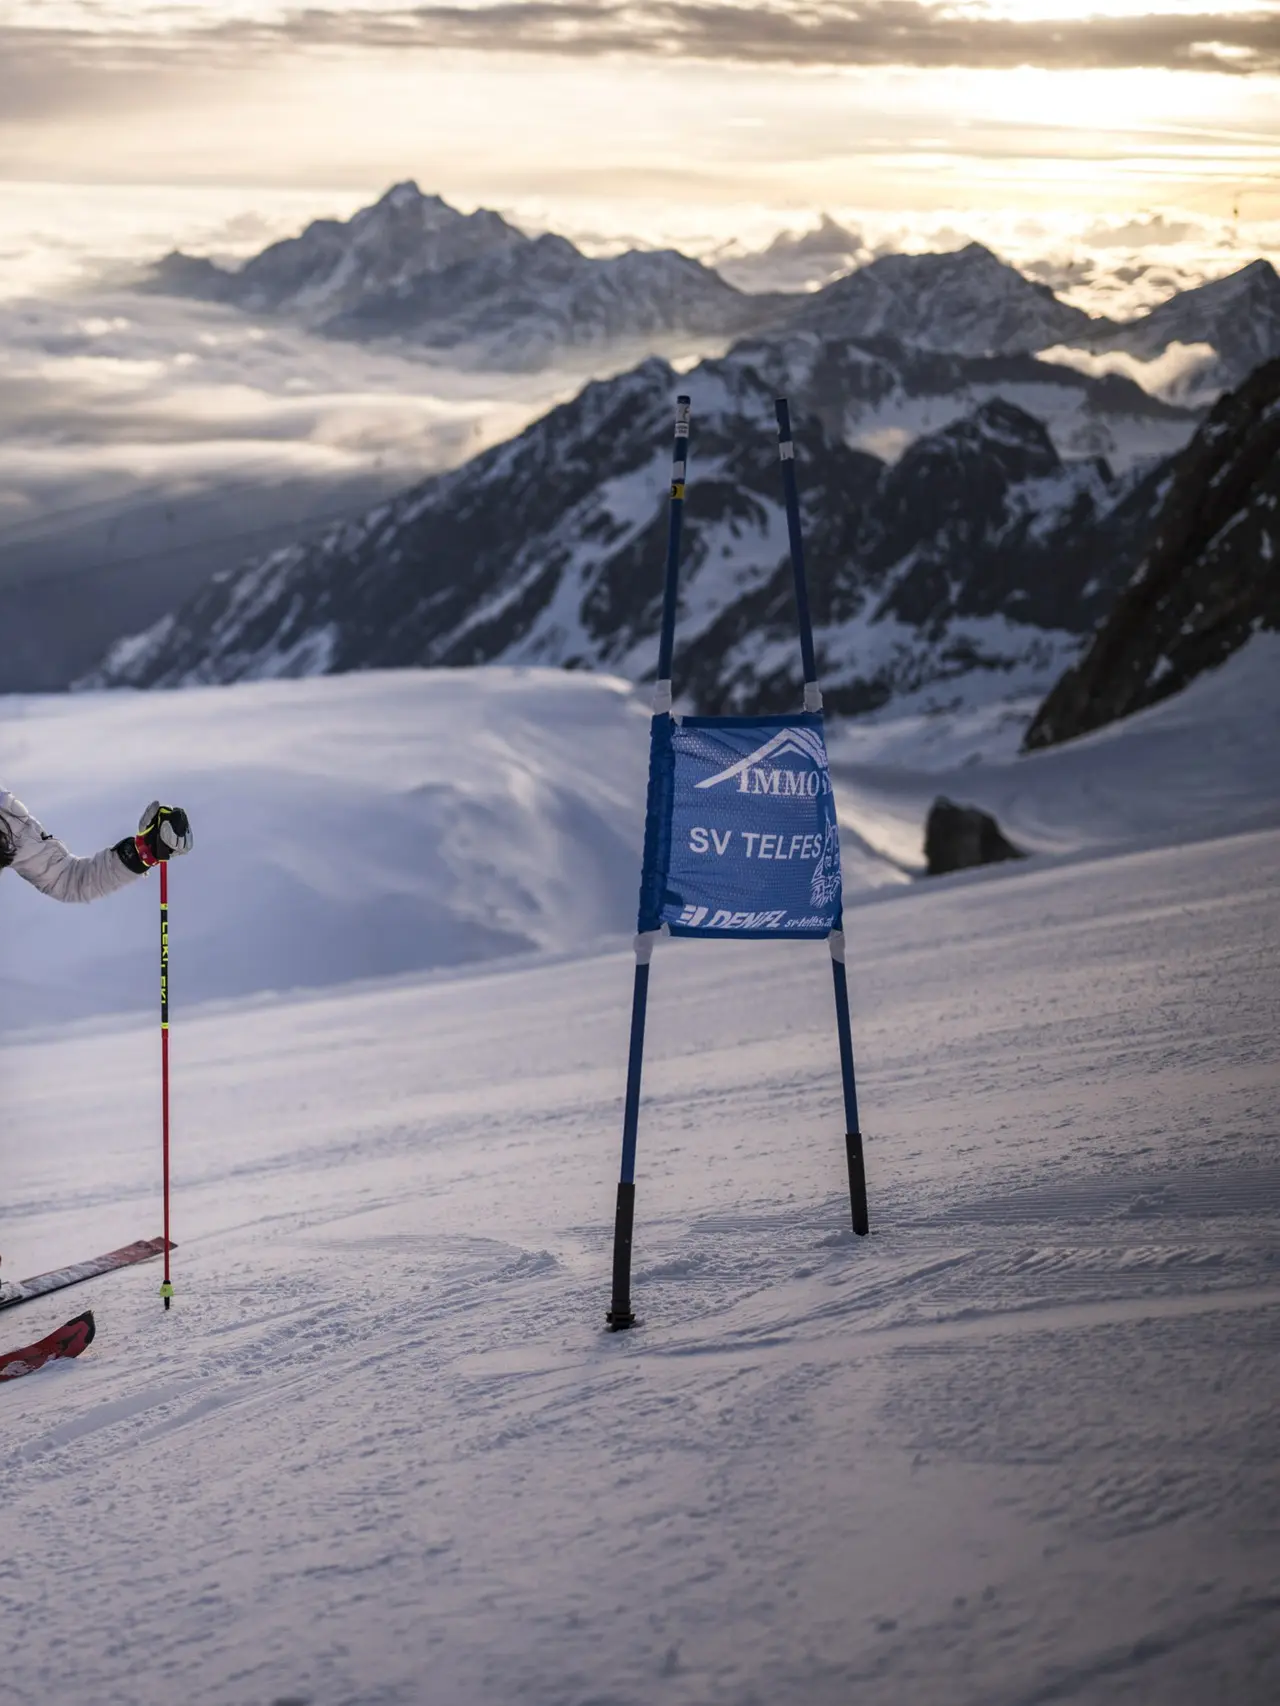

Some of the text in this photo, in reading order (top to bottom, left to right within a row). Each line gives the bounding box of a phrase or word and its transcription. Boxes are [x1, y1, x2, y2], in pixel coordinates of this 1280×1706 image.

[689, 826, 823, 860] SV TELFES
[706, 909, 789, 928] DENIFL
